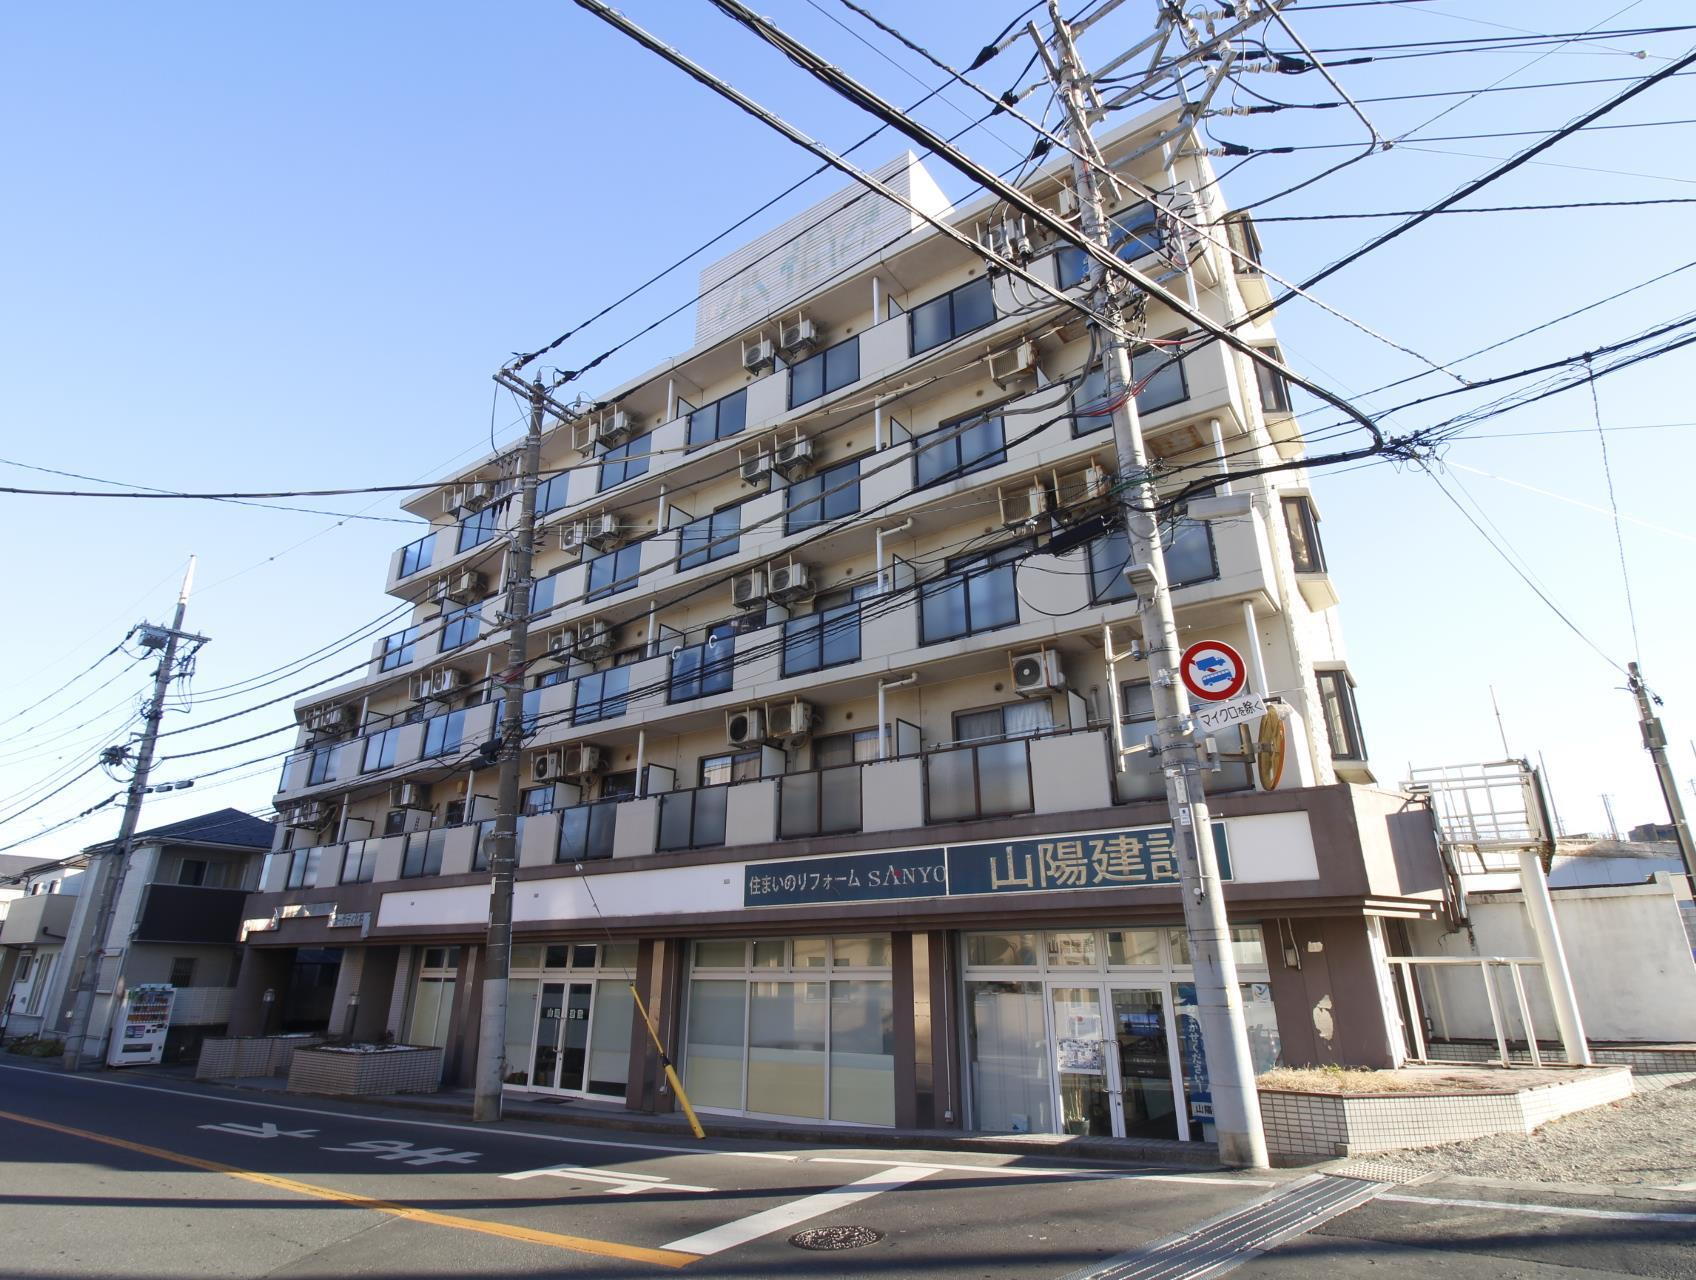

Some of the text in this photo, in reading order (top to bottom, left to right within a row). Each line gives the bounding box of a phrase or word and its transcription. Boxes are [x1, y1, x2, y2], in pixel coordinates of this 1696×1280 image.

[1200, 700, 1263, 727] マイクロを除く
[749, 865, 946, 895] 住まいのリフォーム SANYO
